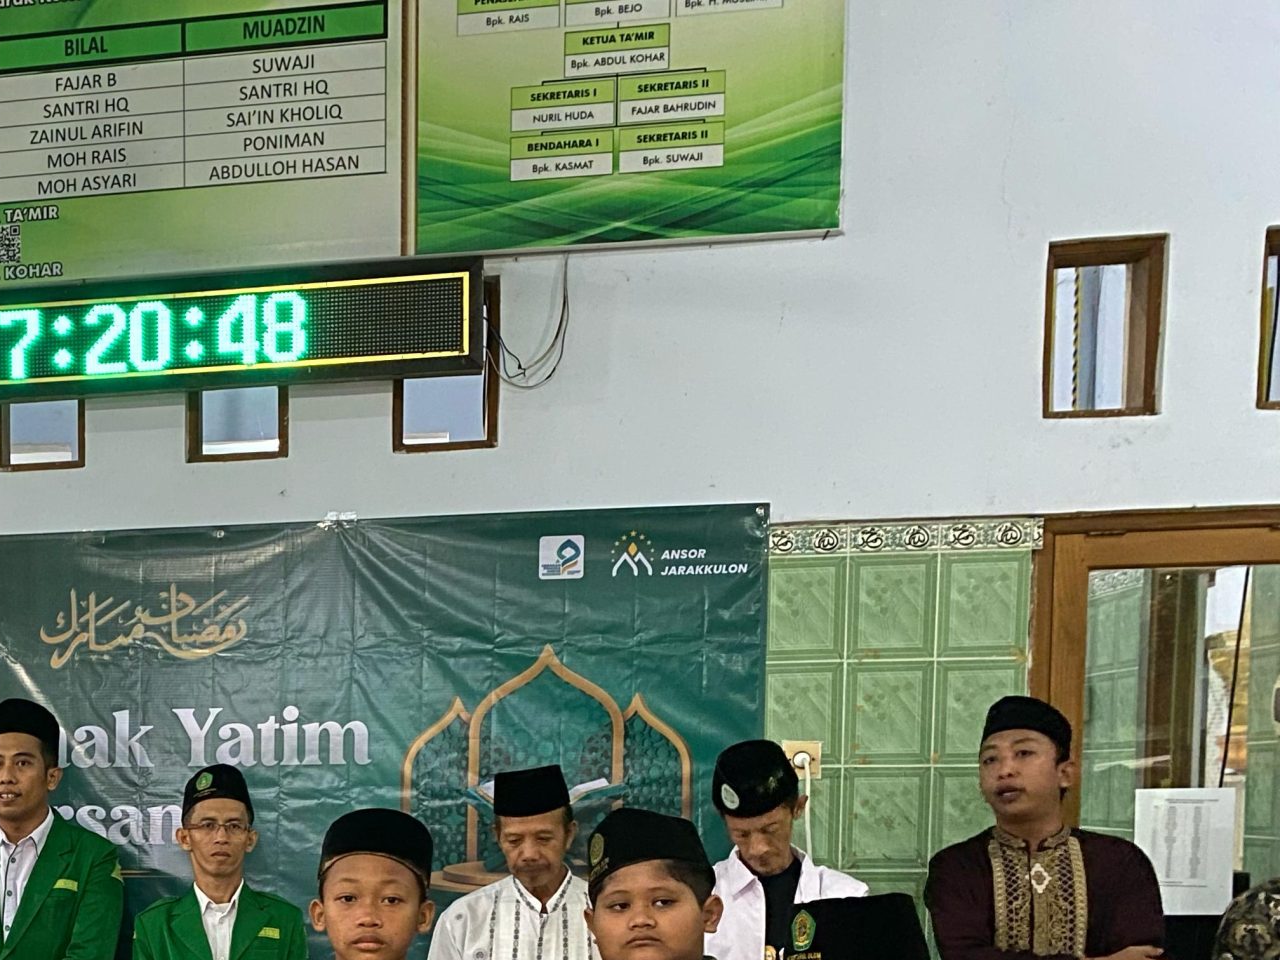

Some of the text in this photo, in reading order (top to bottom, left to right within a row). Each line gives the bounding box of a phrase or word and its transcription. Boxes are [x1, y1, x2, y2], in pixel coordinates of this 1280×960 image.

[594, 3, 643, 18] Bpk. BEJO
[242, 15, 325, 40] MUADZIN
[486, 14, 530, 27] Bpk. RAIS
[64, 36, 109, 57] BILAL
[582, 34, 616, 46] KETUA
[252, 54, 315, 74] SUWAJI
[571, 52, 666, 70] Bpk. ABDUL KOHAR
[55, 73, 117, 93] FAJAR B
[239, 79, 329, 101] SANTRI HQ
[637, 79, 709, 94] SEKRETARIS II
[530, 88, 591, 103] SEKRETARIS
[43, 97, 129, 119] SANTRI HQ
[279, 104, 343, 123] KHOLIQ
[533, 110, 594, 124] NURIL HUDA
[631, 100, 716, 116] FAJAR BAHRUDIN
[30, 121, 144, 145] ZAINUL ARIFIN
[243, 132, 325, 152] PONIMAN
[636, 129, 709, 145] SEKRETARIS II
[527, 138, 593, 153] BENDAHARA
[47, 148, 127, 168] MOH RAIS
[642, 152, 704, 167] Bpk. SUWAJI
[209, 155, 360, 181] ABDULLOH HASAN
[532, 160, 594, 175] Bpk. KASMAT
[37, 173, 137, 195] MOH ASYARI
[4, 262, 62, 280] KOHAR
[660, 548, 707, 560] ANSOR
[660, 563, 748, 576] JARAKKULON
[172, 705, 372, 768] Yatim
